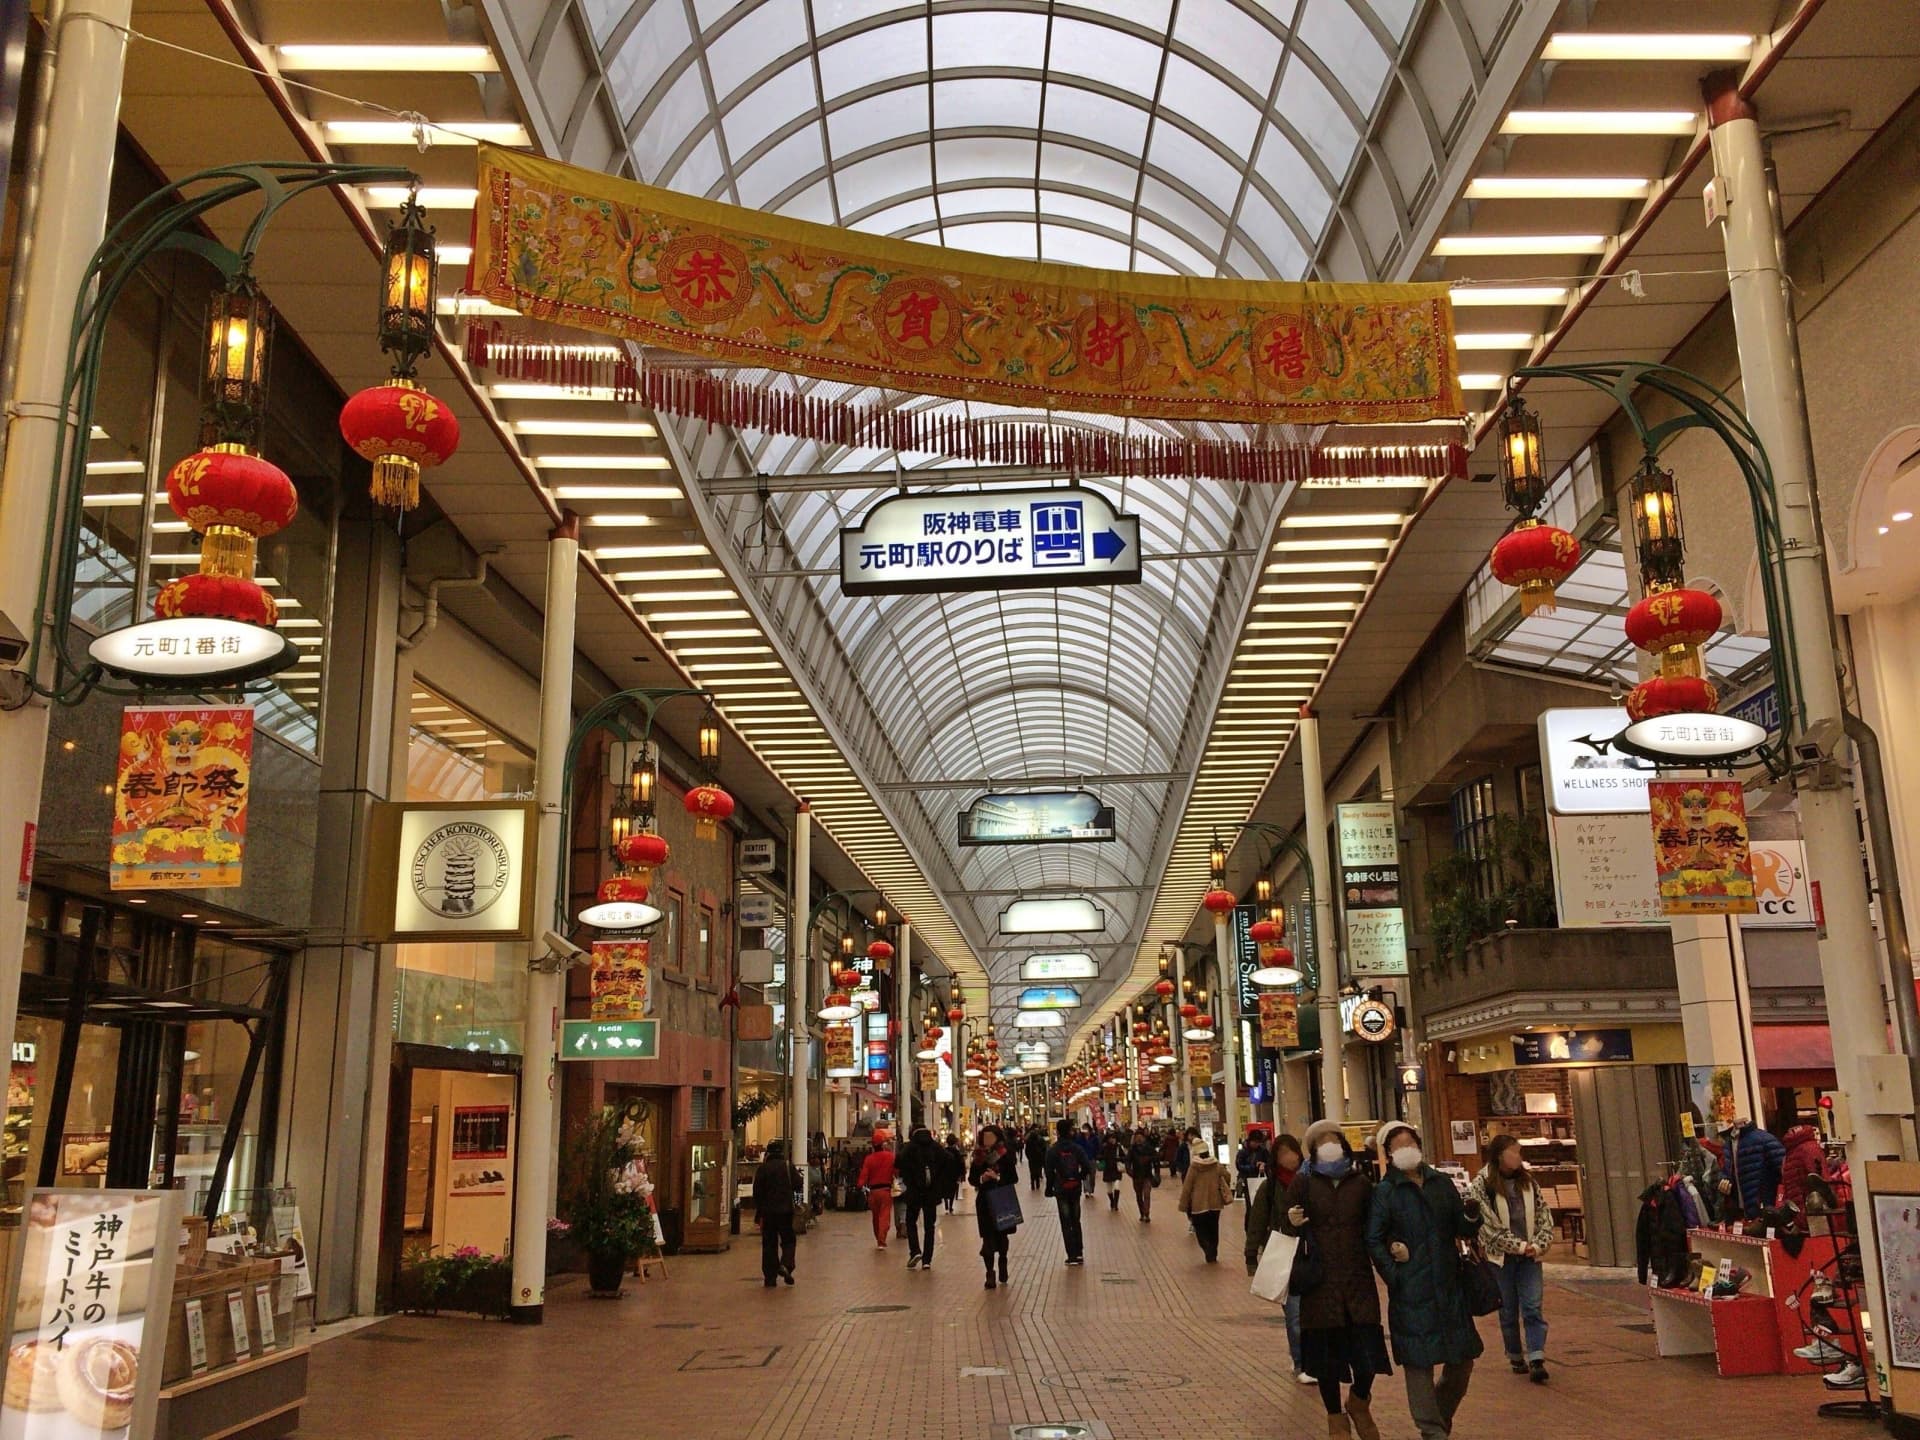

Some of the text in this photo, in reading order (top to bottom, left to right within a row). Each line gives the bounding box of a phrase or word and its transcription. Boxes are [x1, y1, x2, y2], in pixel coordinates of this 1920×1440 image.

[923, 509, 1022, 536] 阪神電車
[859, 537, 1024, 570] 元町駅のりば
[134, 637, 241, 656] 元町1番街
[1659, 726, 1735, 742] 元町1番街
[121, 767, 245, 800] 春節祭
[1563, 777, 1649, 790] WELLNESS SHOP
[1657, 825, 1745, 849] 春節祭
[414, 824, 507, 891] DEUTSCHER KONDITORENBUND
[83, 1213, 124, 1325] 神戸牛の
[48, 1230, 81, 1353] ミートパイ
